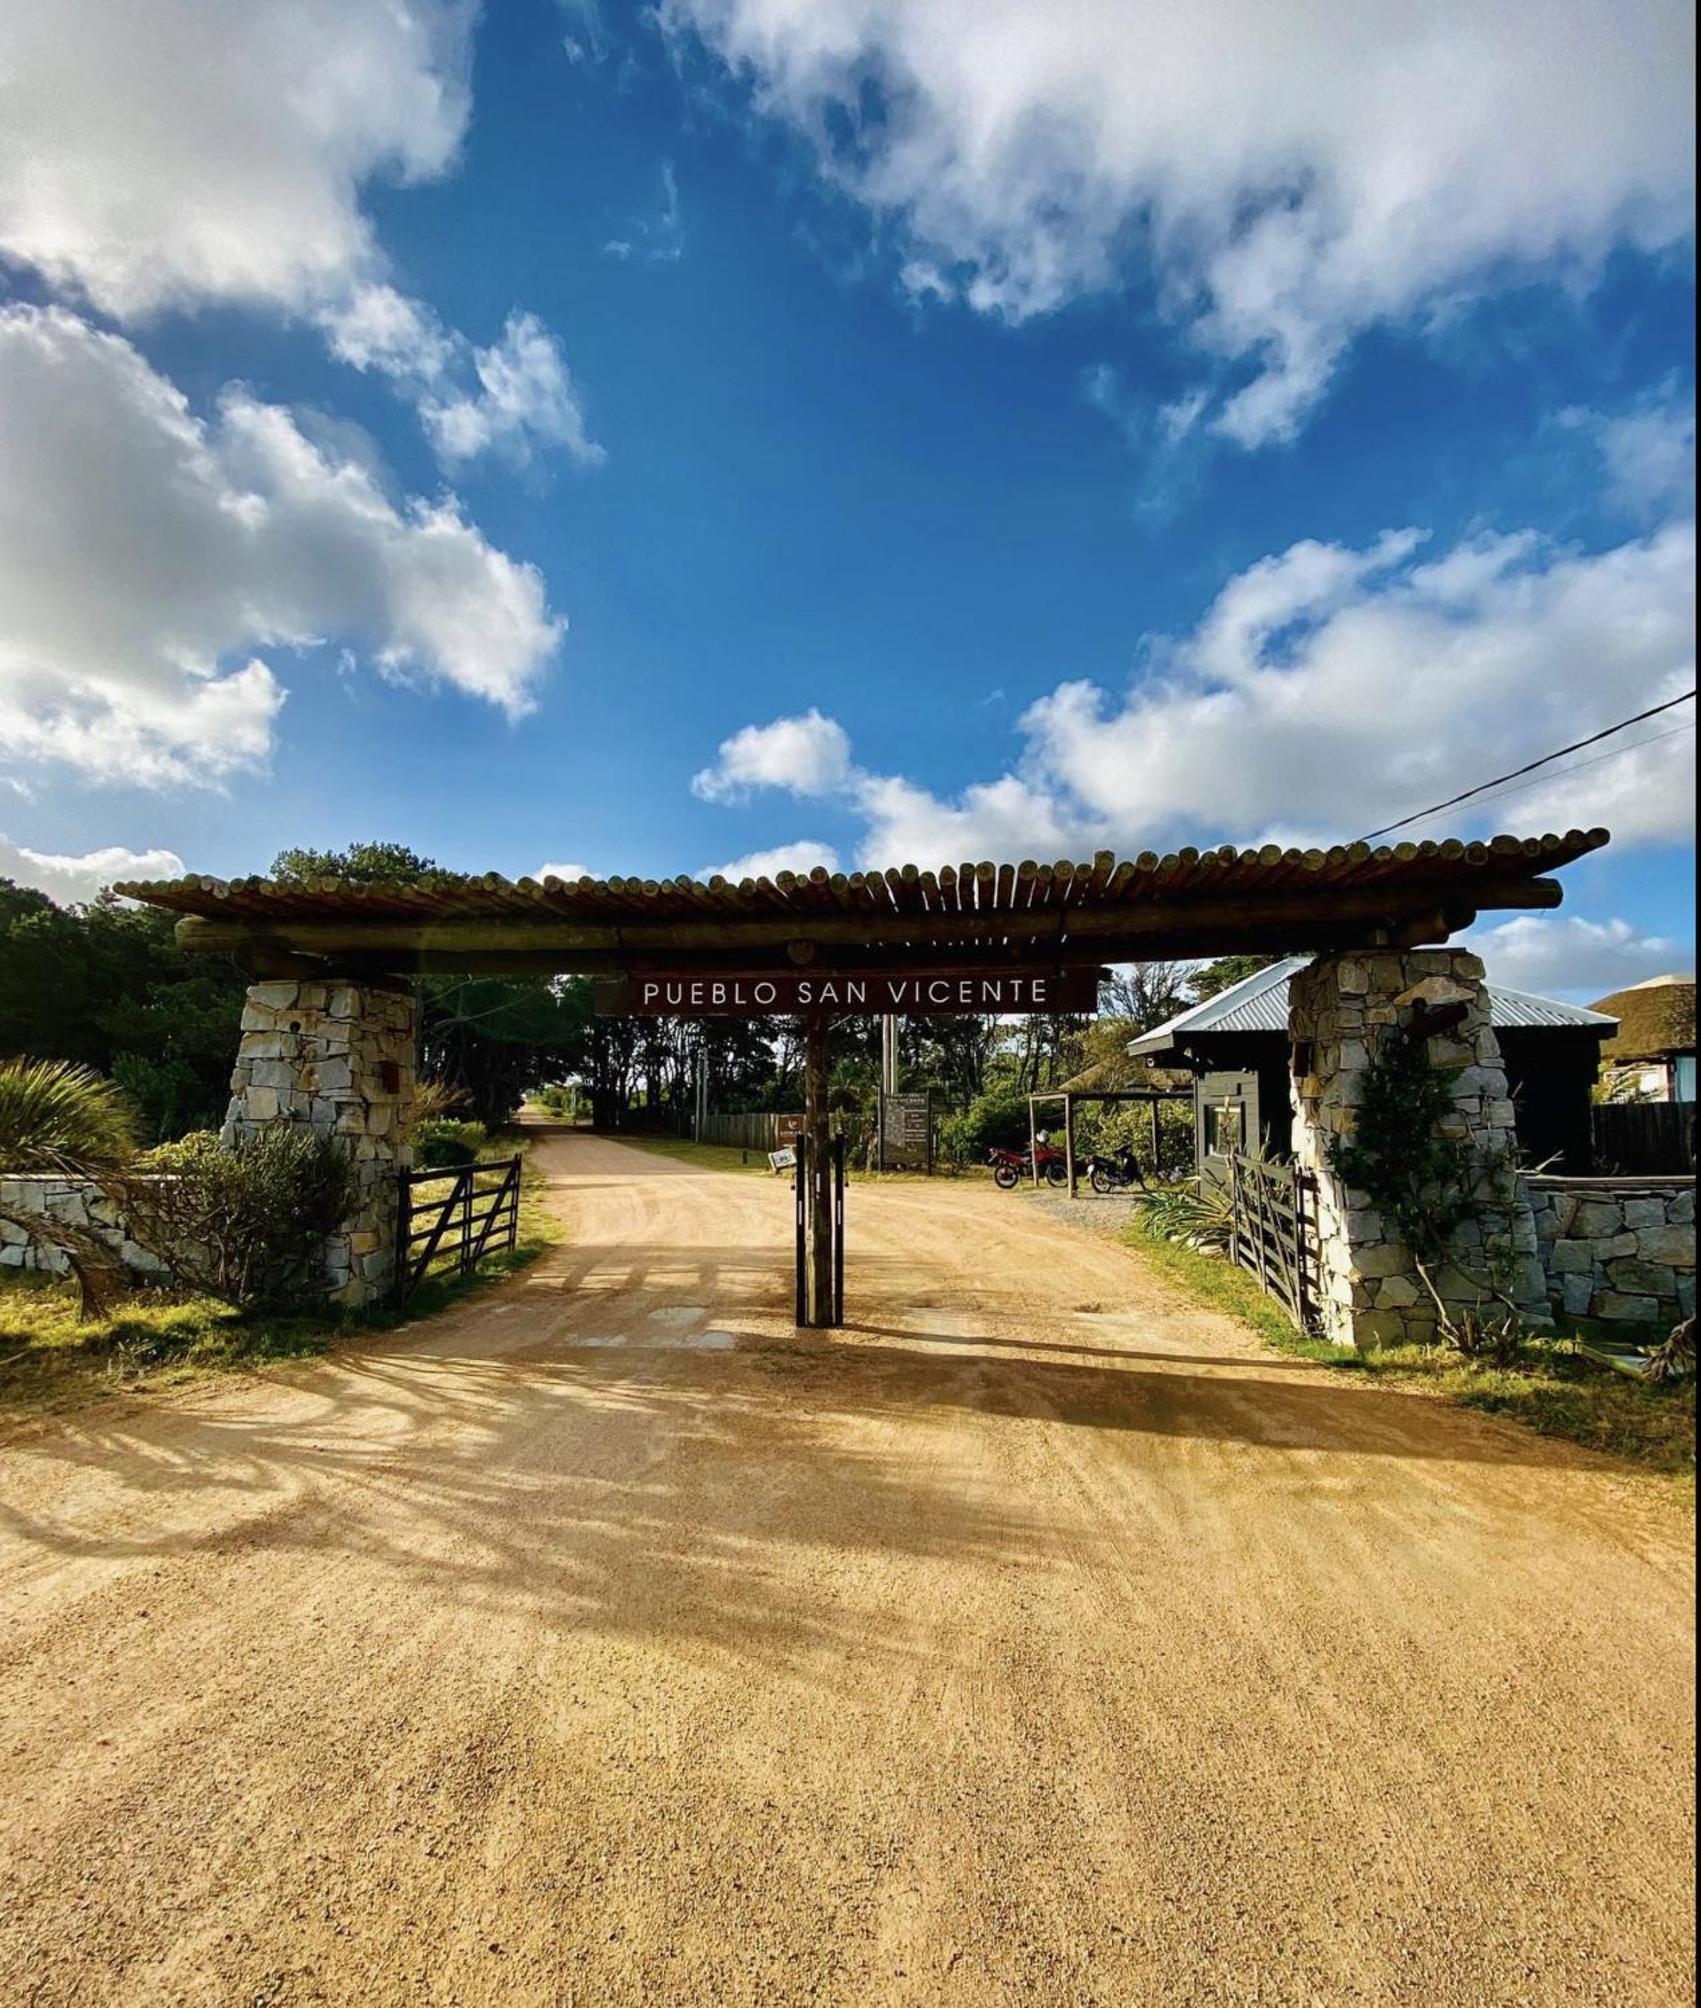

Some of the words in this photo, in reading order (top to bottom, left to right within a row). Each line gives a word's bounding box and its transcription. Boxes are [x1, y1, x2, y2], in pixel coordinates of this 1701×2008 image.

[644, 982, 776, 1005] PUEBLO
[797, 981, 866, 1004] SAN
[887, 979, 1046, 1004] VICENTE
